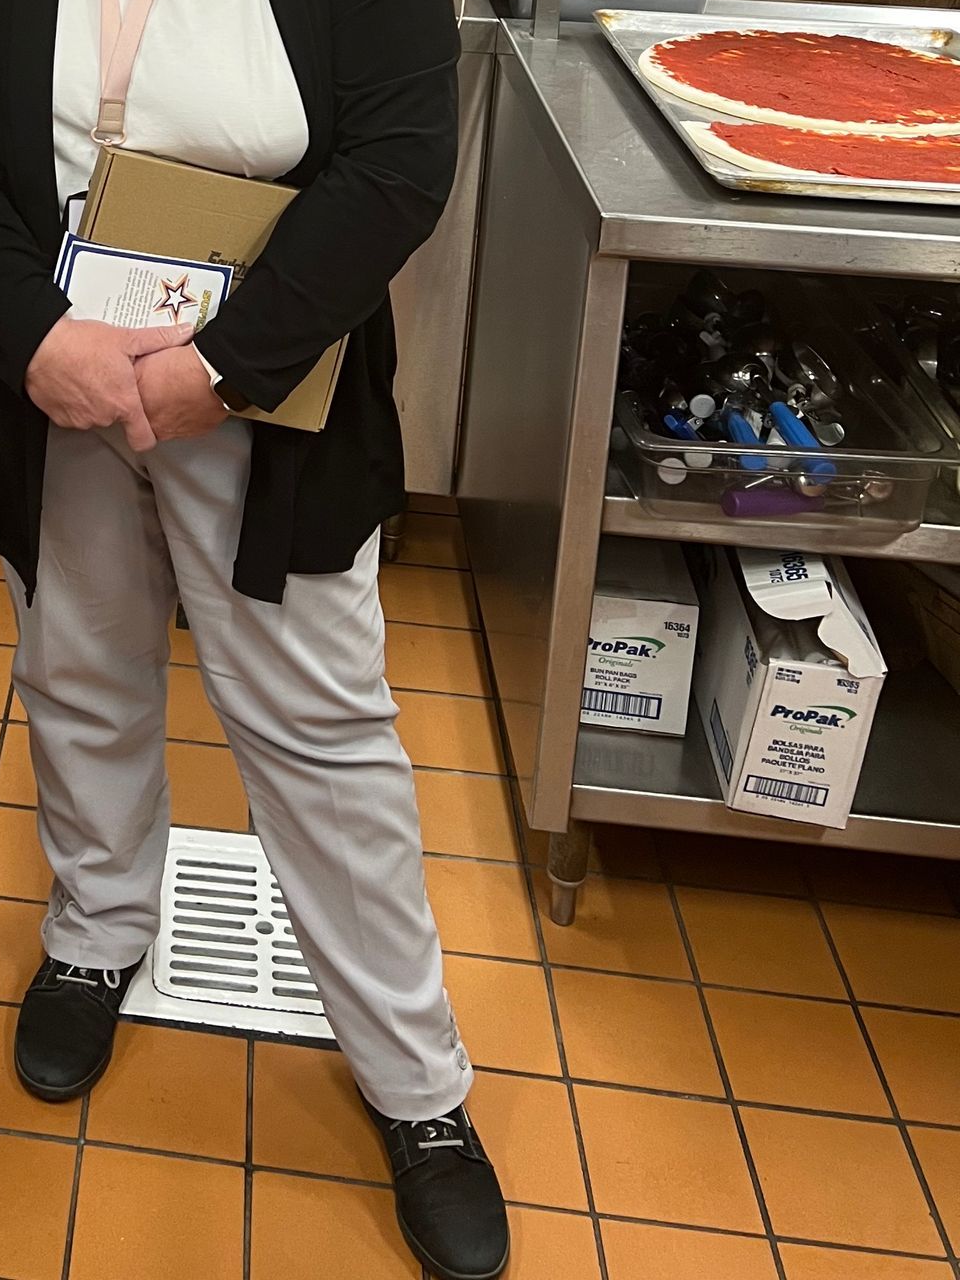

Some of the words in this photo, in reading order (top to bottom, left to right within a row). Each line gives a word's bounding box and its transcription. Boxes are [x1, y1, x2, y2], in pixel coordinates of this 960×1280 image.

[770, 705, 842, 727] ProPak
[768, 745, 803, 756] BANDEJA
[805, 752, 825, 760] PARA
[772, 739, 803, 749] BOLSAS
[804, 745, 824, 753] PARA
[761, 758, 797, 769] PAQUETE
[797, 764, 825, 773] PLANO
[779, 754, 810, 764] BOLLOS
